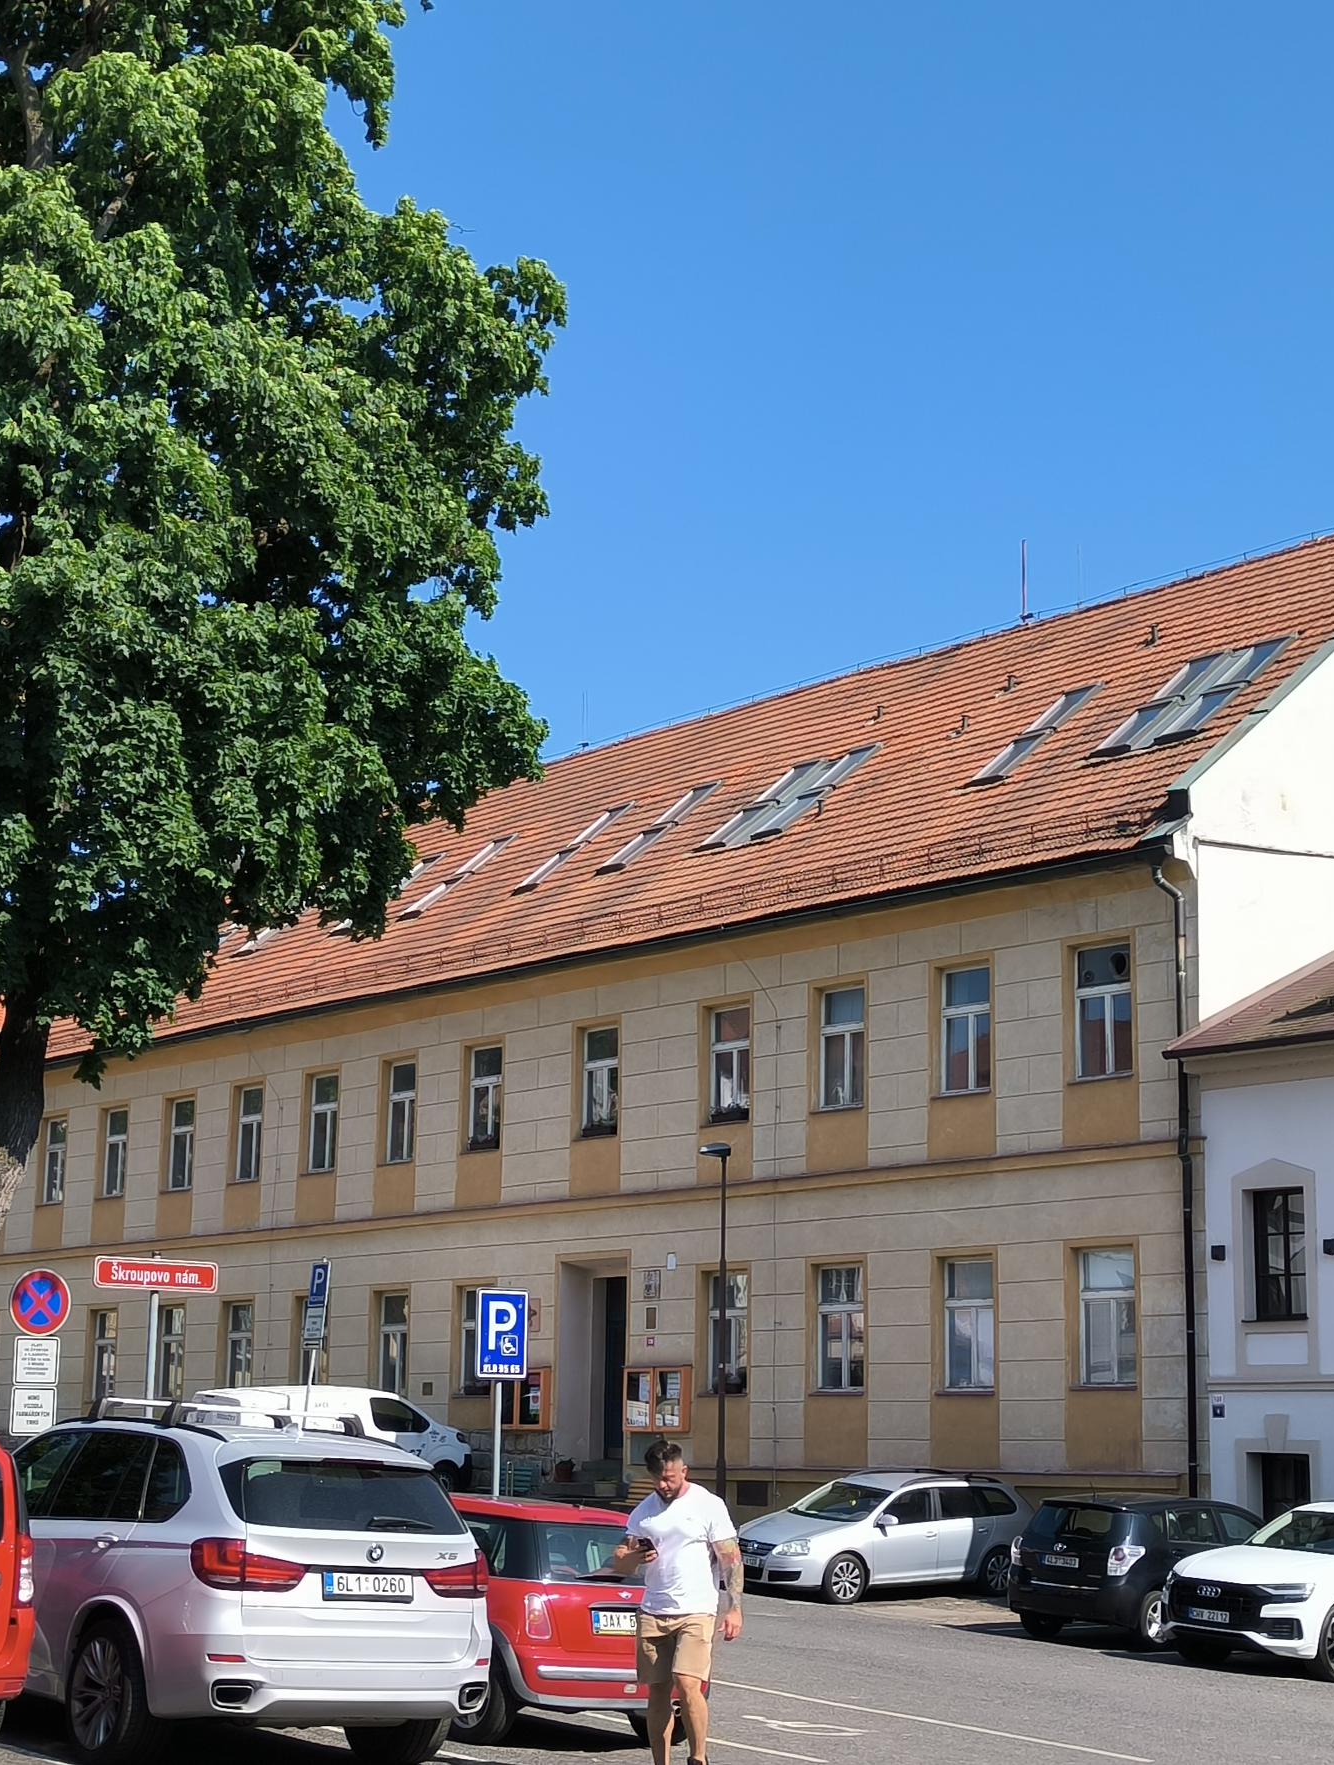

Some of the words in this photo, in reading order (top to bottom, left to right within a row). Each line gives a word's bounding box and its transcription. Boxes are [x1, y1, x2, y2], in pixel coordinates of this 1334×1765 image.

[110, 1260, 170, 1287] Škroupovo
[175, 1269, 202, 1285] nám.
[313, 1268, 325, 1294] P
[487, 1300, 517, 1351] P
[435, 1551, 459, 1561] X5
[337, 1575, 362, 1592] 6L1
[372, 1576, 406, 1593] 0260
